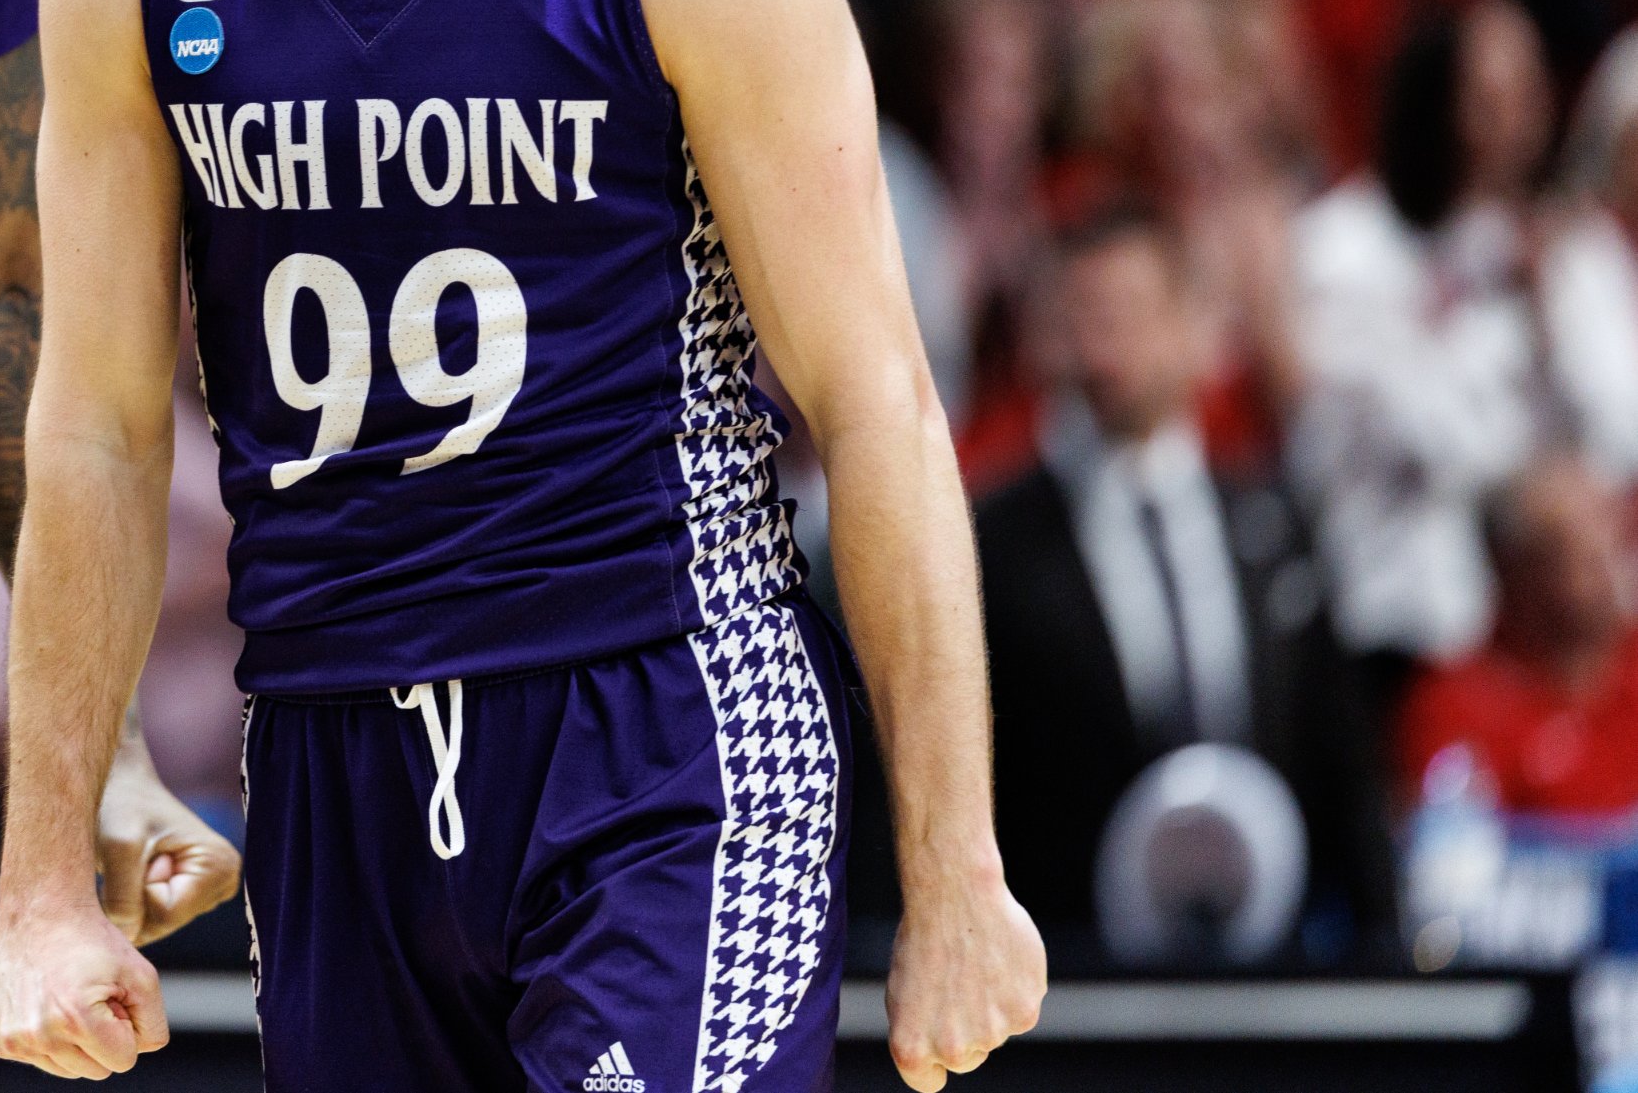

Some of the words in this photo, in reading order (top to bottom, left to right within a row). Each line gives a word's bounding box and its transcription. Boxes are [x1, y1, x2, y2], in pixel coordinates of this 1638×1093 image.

[177, 39, 219, 57] NCAA
[169, 99, 332, 210] HIGH
[356, 98, 608, 209] POINT
[263, 248, 527, 489] 99
[583, 1074, 645, 1093] adidas
